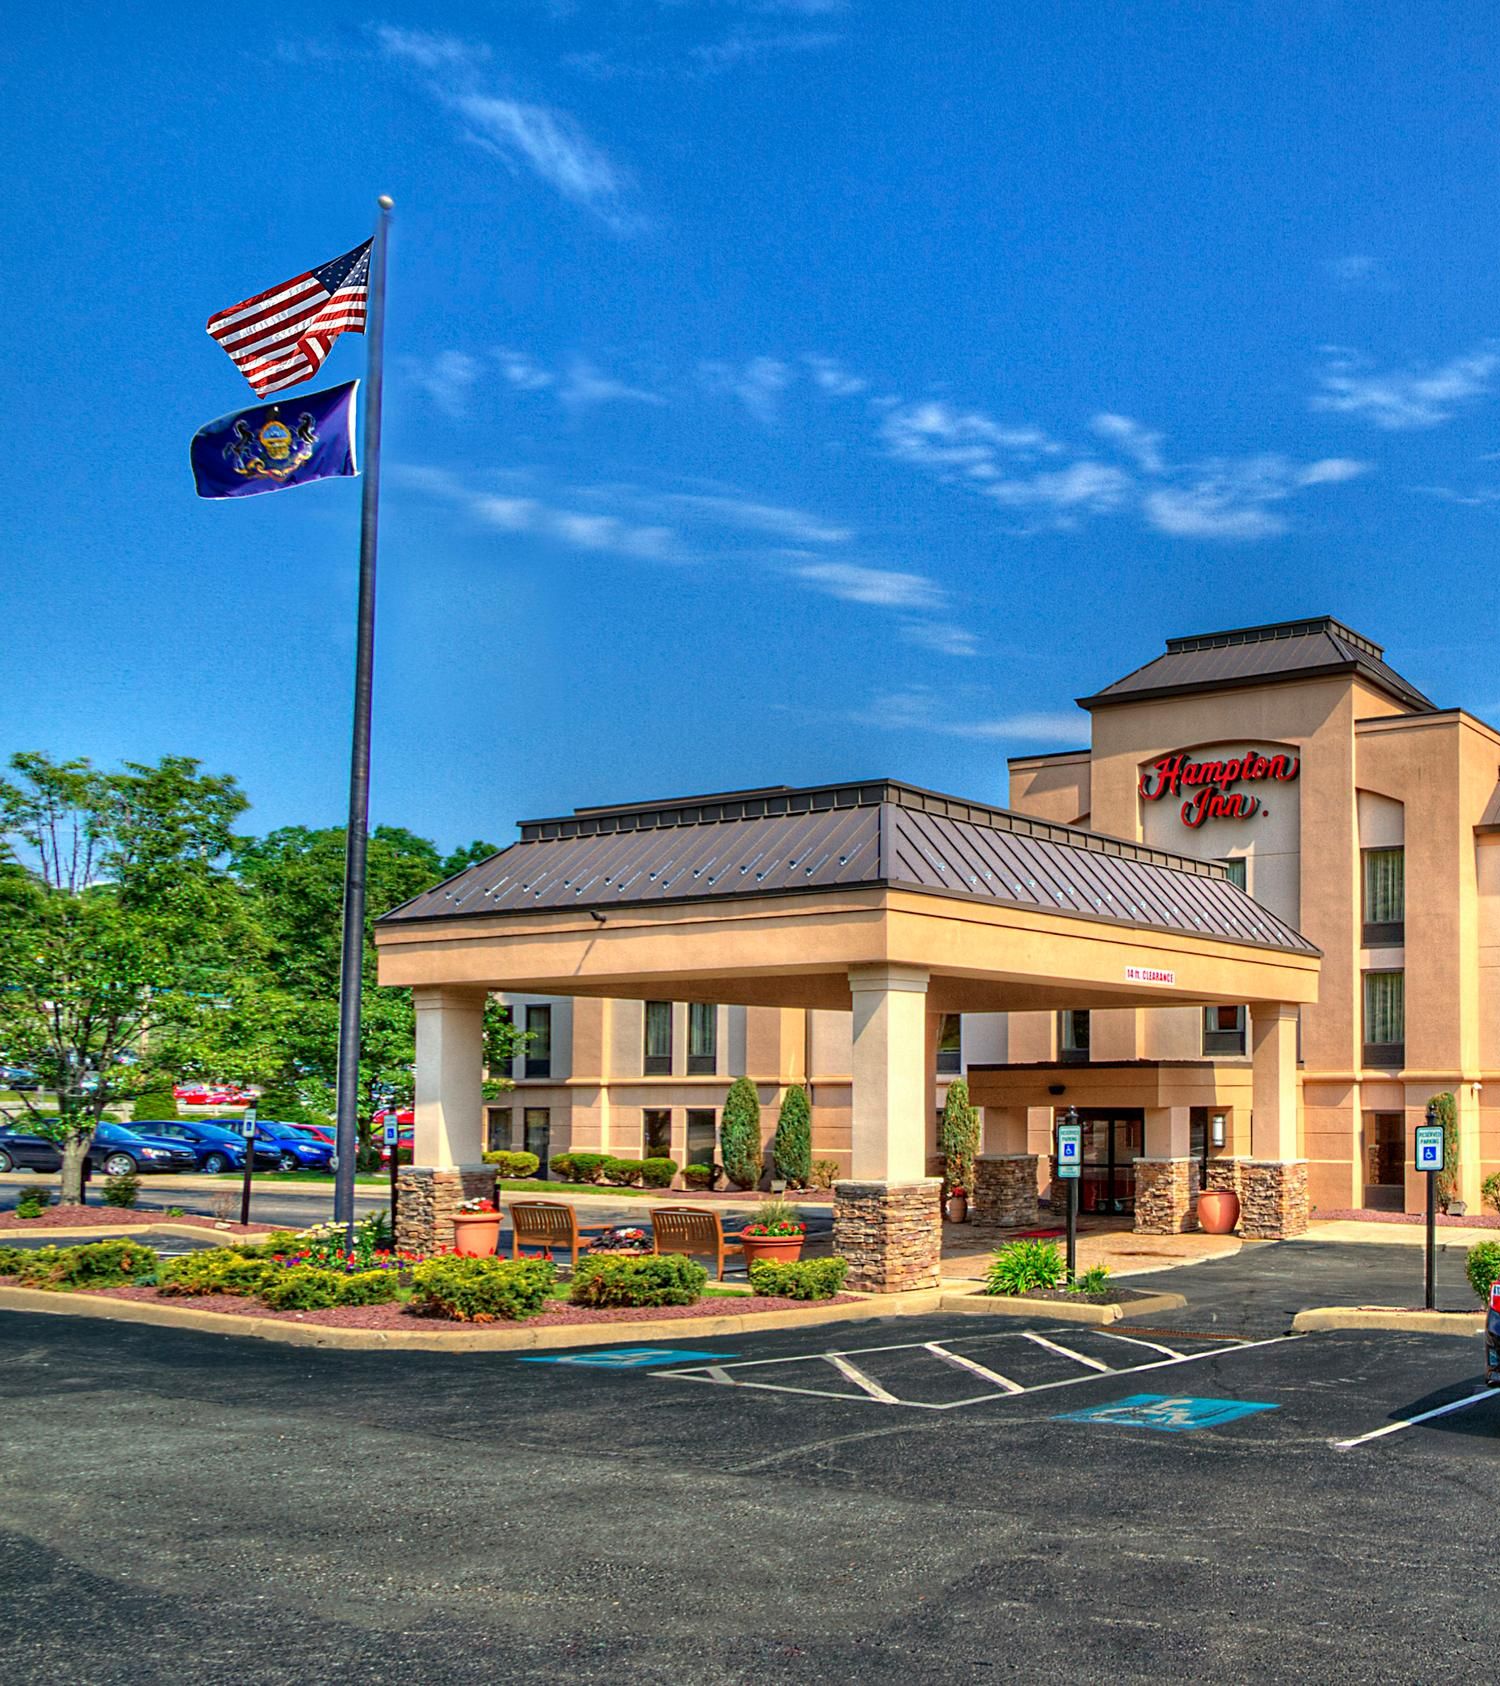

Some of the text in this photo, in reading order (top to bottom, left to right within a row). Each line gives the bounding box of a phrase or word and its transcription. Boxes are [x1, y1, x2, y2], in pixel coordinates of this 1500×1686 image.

[1139, 751, 1300, 801] Hampton
[1181, 786, 1260, 829] Inn
[1142, 970, 1173, 983] CLEARANCE
